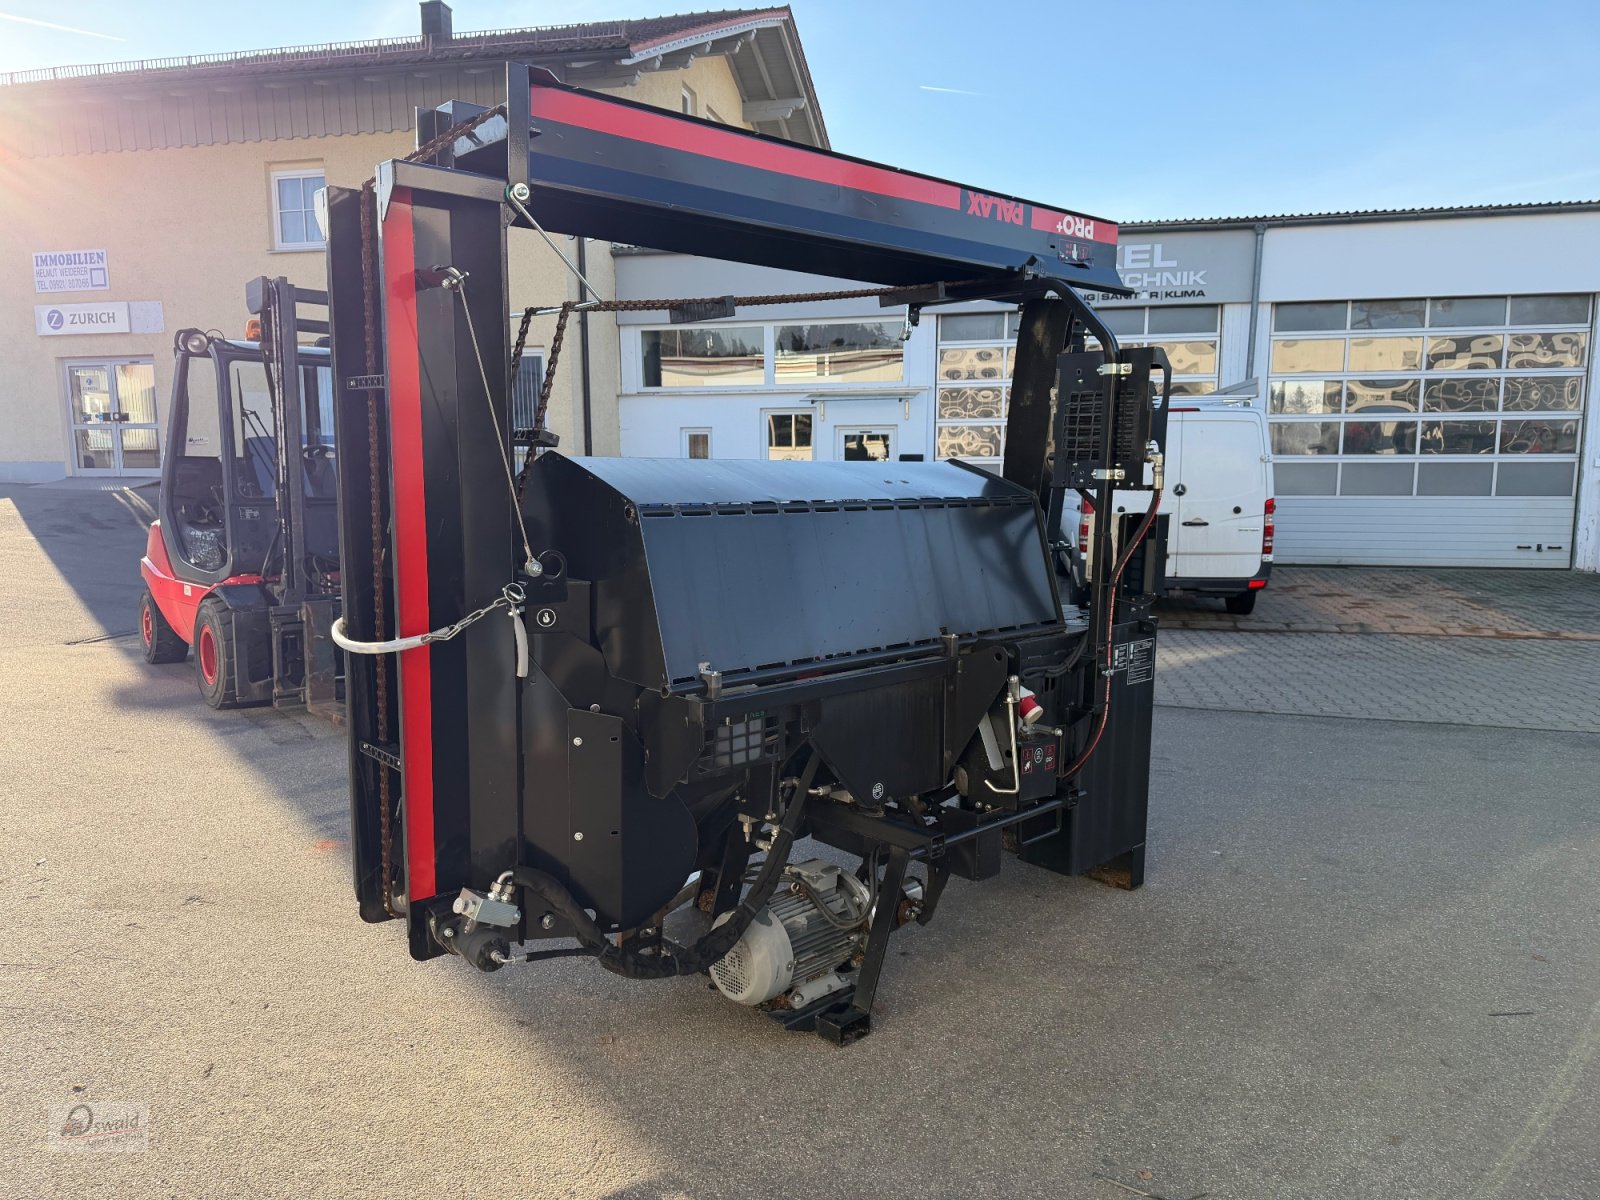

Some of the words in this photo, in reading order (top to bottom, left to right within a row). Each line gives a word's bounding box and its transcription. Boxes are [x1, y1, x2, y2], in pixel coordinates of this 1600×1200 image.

[967, 190, 1024, 226] PALAX
[1056, 215, 1095, 240] PRO+
[35, 252, 104, 267] IMMOBILIEN
[1116, 244, 1178, 269] EL
[36, 267, 59, 278] HELMUT
[60, 266, 88, 277] WEIDERER
[1119, 270, 1207, 288] CHNIK
[1164, 289, 1206, 299] KLIMA
[69, 311, 116, 325] ZURICH
